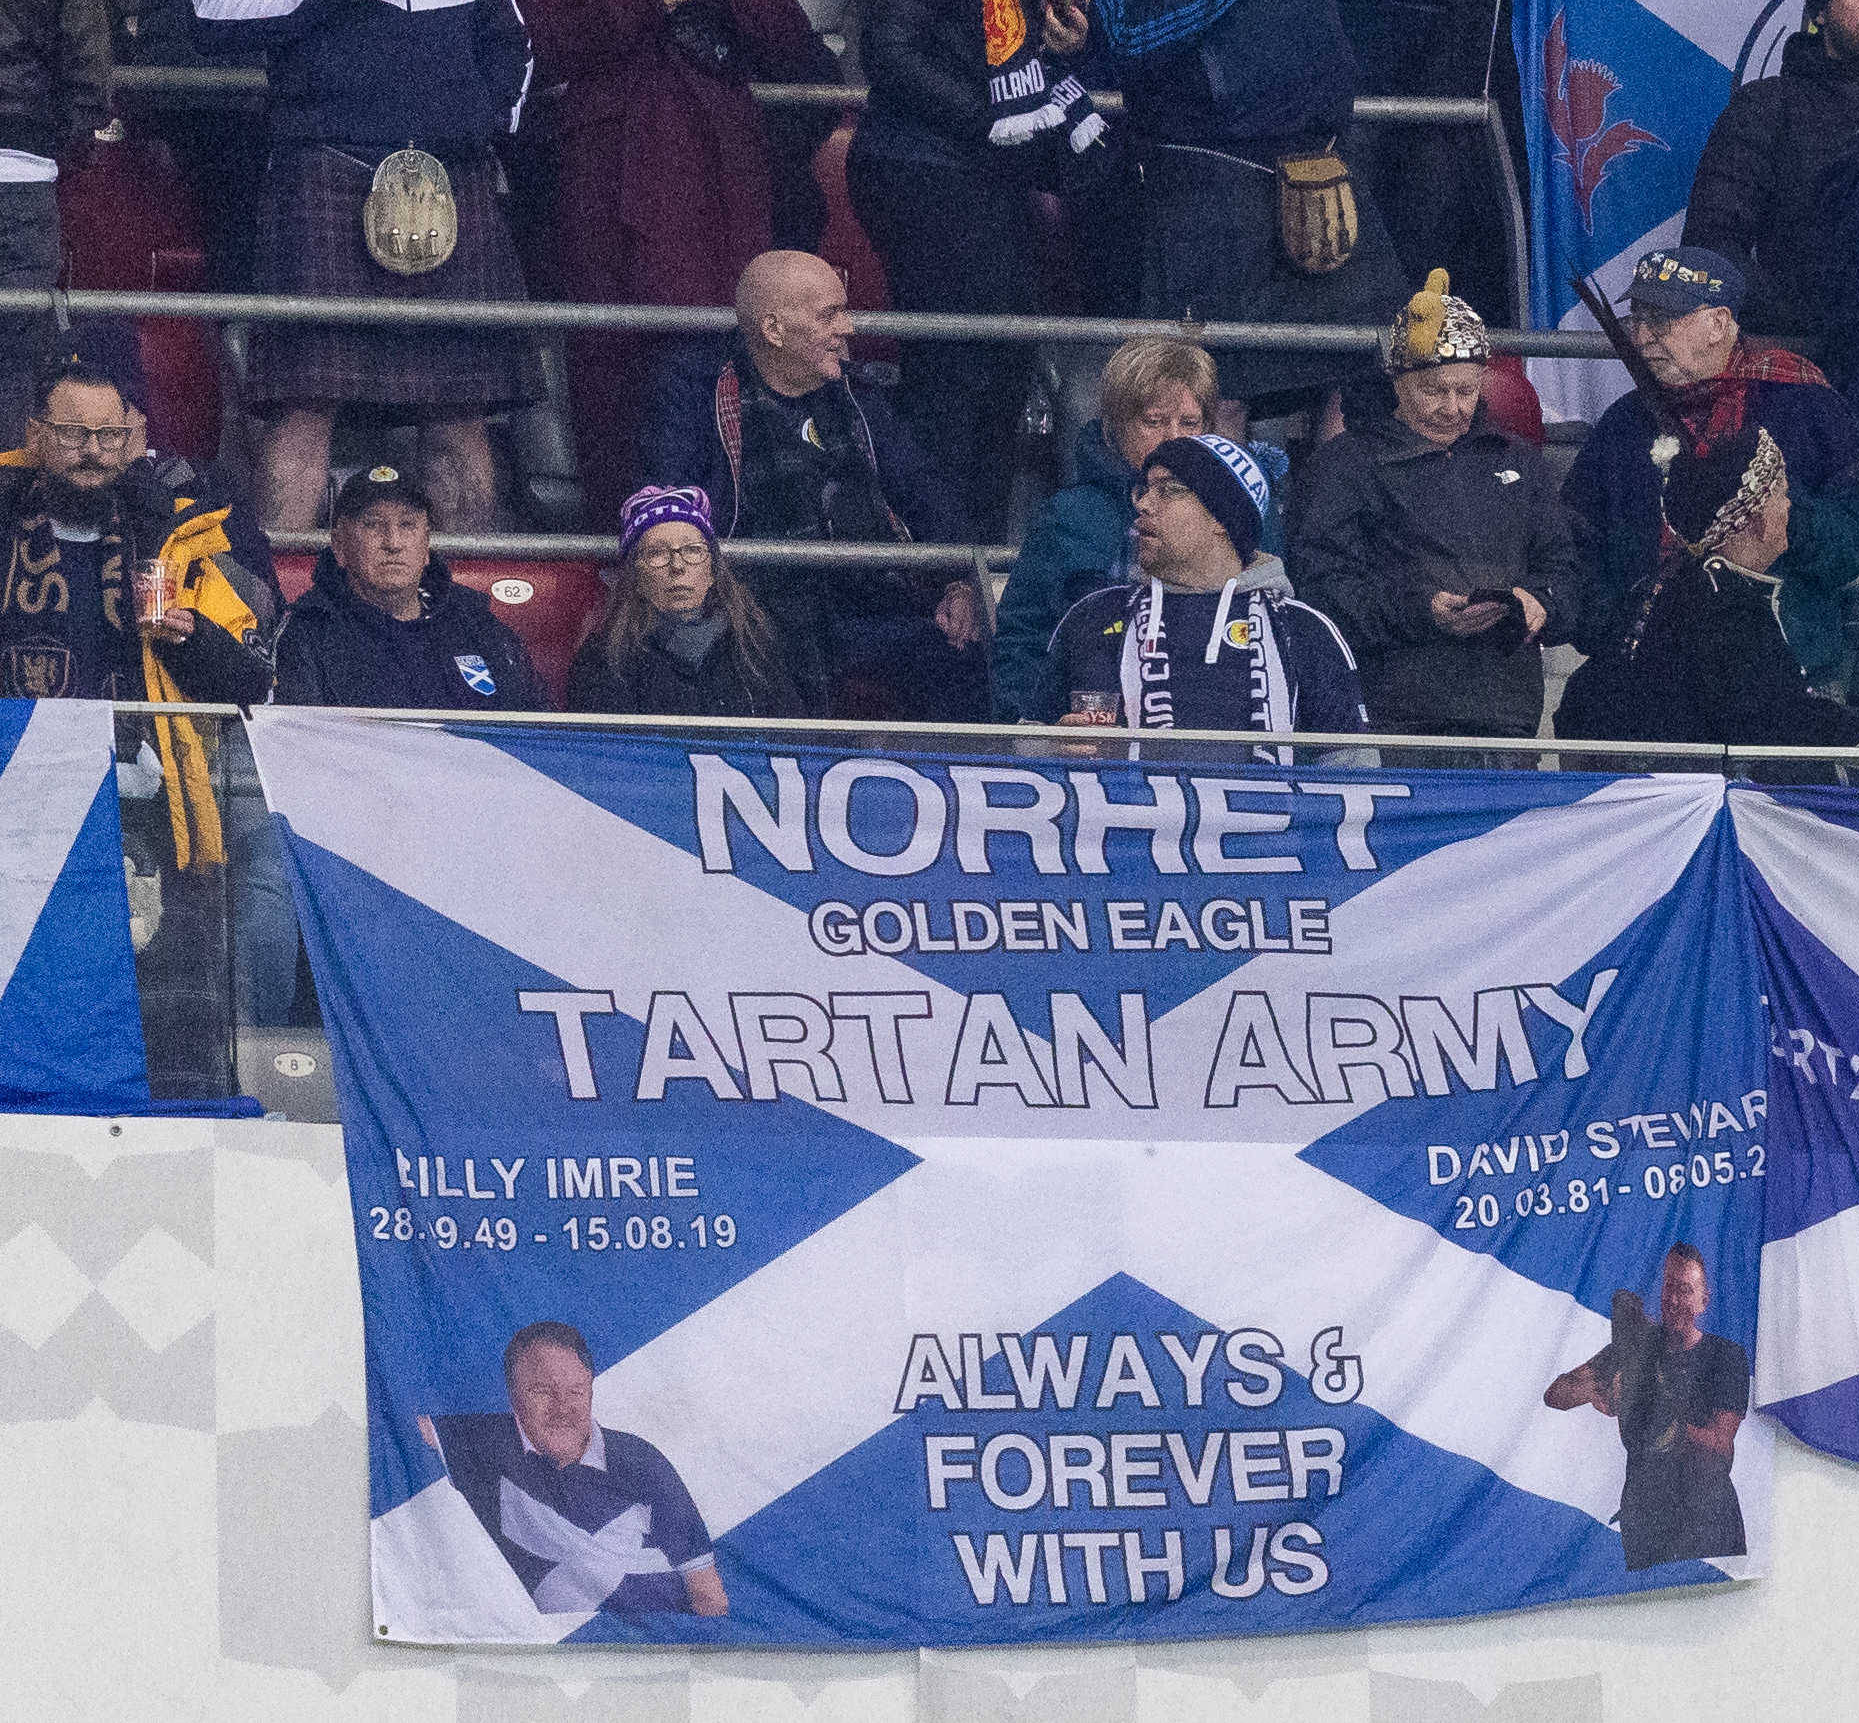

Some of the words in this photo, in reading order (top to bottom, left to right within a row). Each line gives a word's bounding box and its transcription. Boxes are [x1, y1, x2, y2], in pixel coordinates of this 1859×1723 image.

[989, 59, 1043, 104] TLAND
[502, 585, 519, 599] 62
[691, 753, 1411, 873] NORHET
[809, 902, 1086, 956] GOLDEN
[1109, 900, 1331, 954] EAGLE
[519, 990, 1160, 1108] TARTAN
[1204, 968, 1621, 1108] ARMY
[547, 1156, 699, 1198] IMRIE
[1427, 1129, 1569, 1186] DAVID
[1586, 1090, 1767, 1159] STEWAR
[370, 1206, 518, 1250] 28.9.49
[563, 1214, 737, 1251] 15.08.19
[895, 1332, 1286, 1414] ALWAYS
[1311, 1329, 1364, 1402] &
[925, 1429, 1344, 1510] FOREVER
[954, 1529, 1183, 1607] WITH
[1209, 1522, 1329, 1598] US
